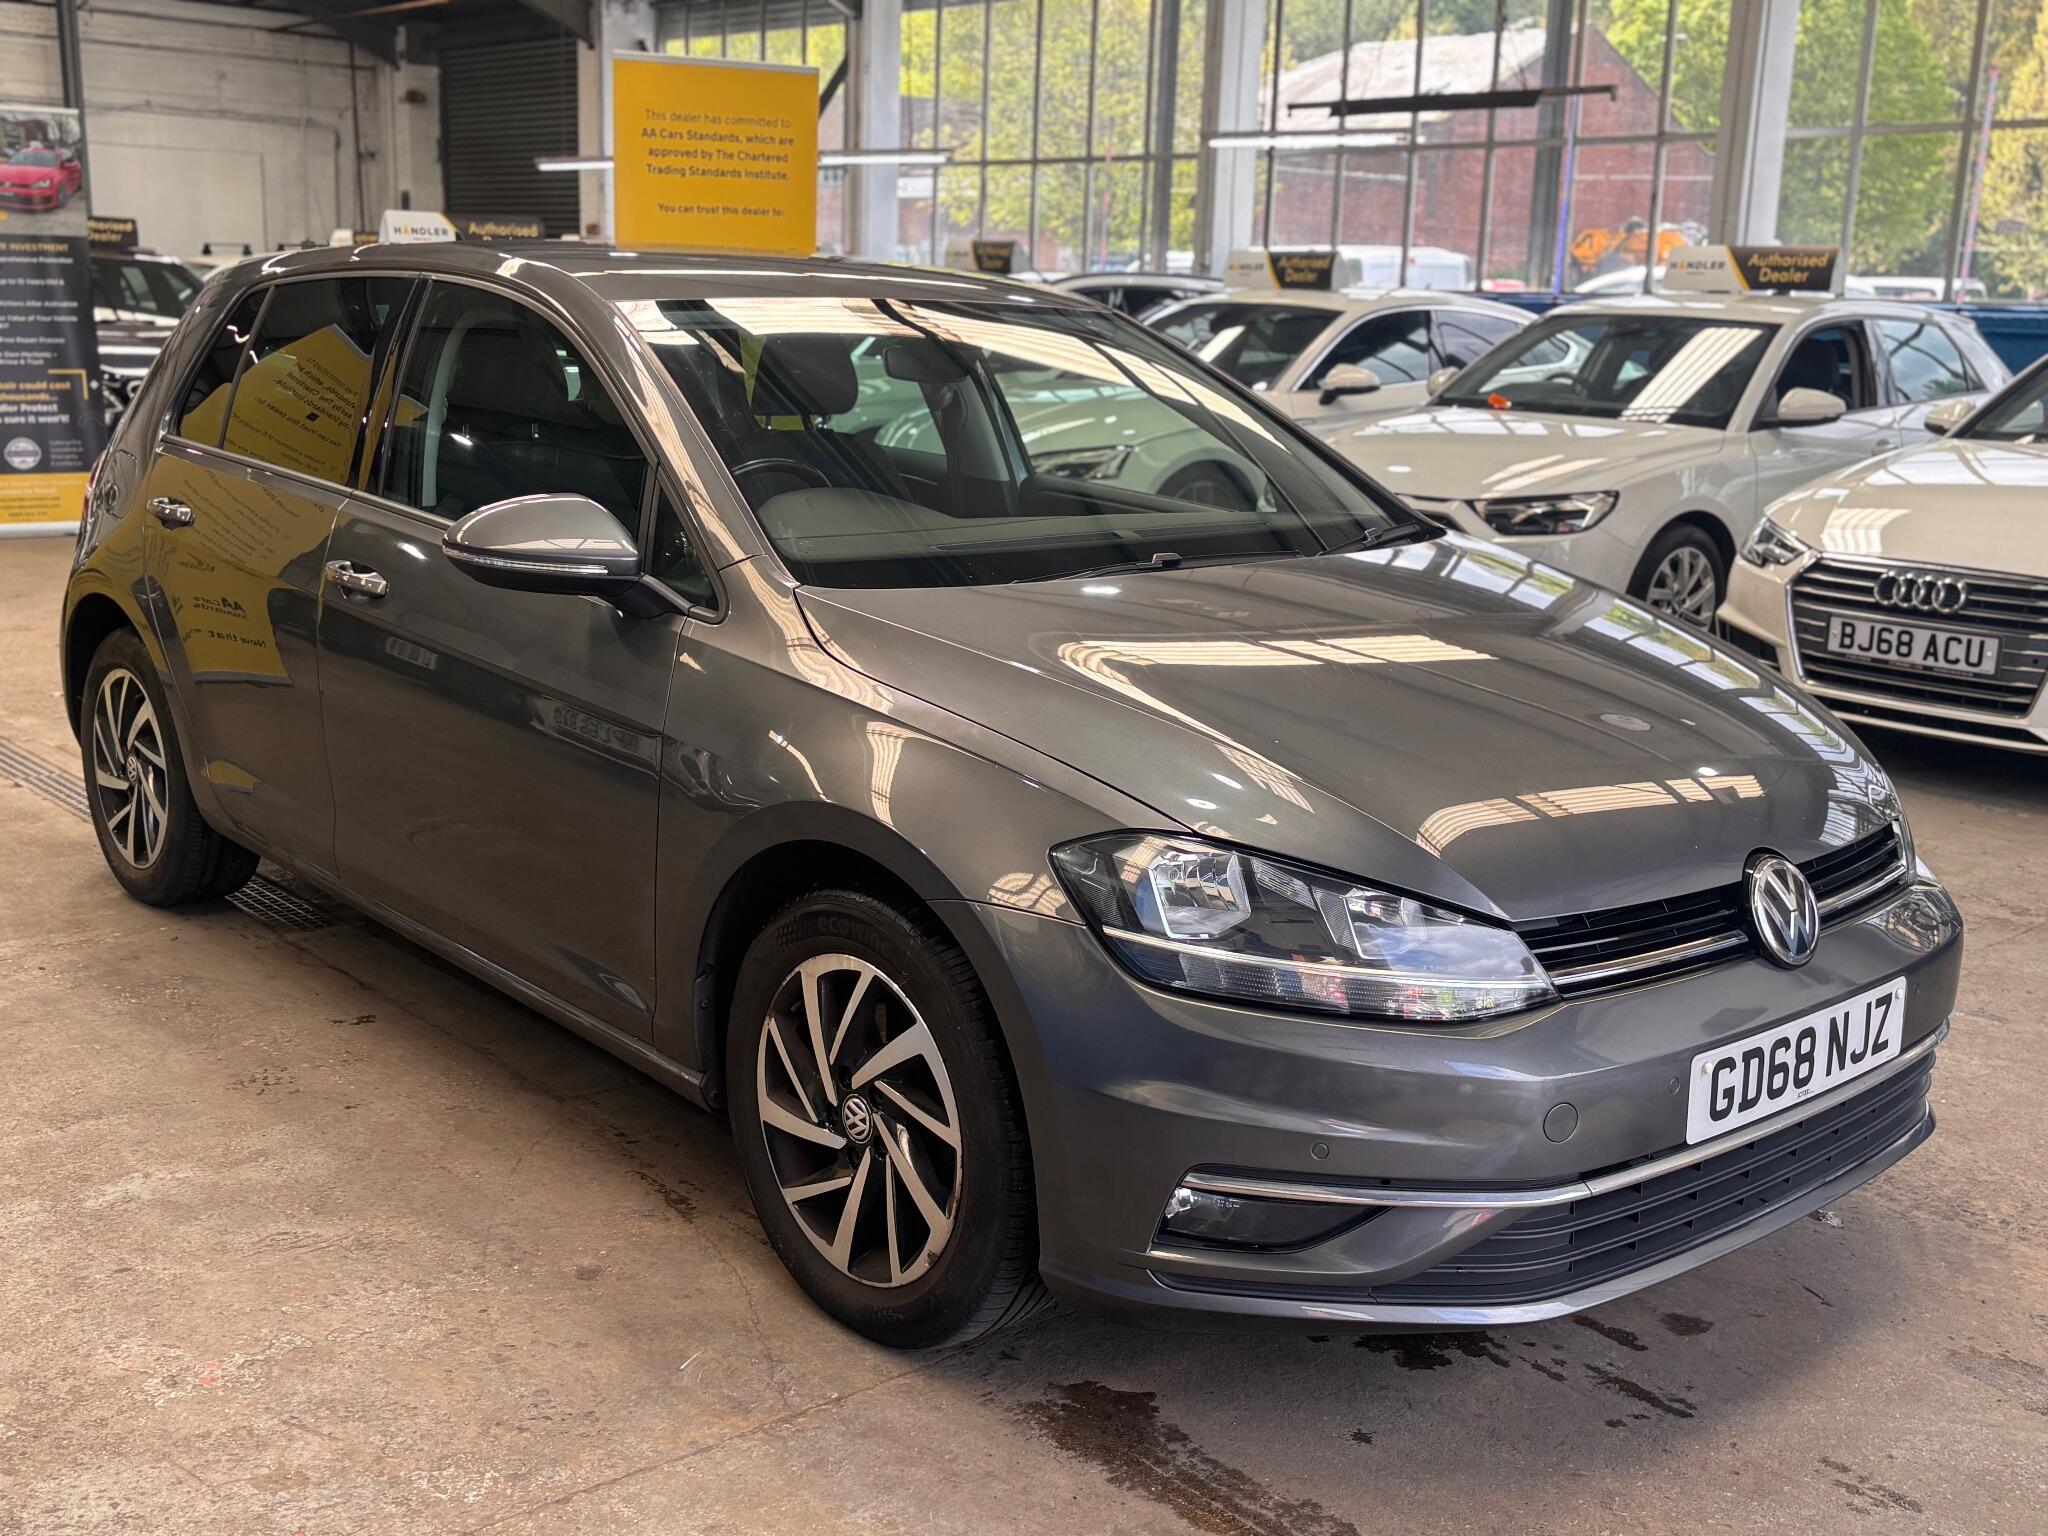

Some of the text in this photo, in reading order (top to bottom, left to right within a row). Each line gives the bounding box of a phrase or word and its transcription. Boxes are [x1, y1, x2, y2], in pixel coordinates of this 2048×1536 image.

[645, 108, 791, 129] This dealer has committed to
[641, 127, 794, 146] AA Cars Standards, which are
[648, 147, 789, 164] approved by The Chartered
[646, 163, 791, 181] Trading Standards Institute.
[658, 203, 784, 217] You can trust this dealer to:
[468, 221, 539, 238] Authorised
[1747, 252, 1829, 268] Authorised
[1758, 268, 1809, 283] Dealer
[1838, 620, 1915, 658] BJ68
[1922, 632, 1986, 668] ACU
[1709, 992, 1893, 1122] GD68 NJZ
